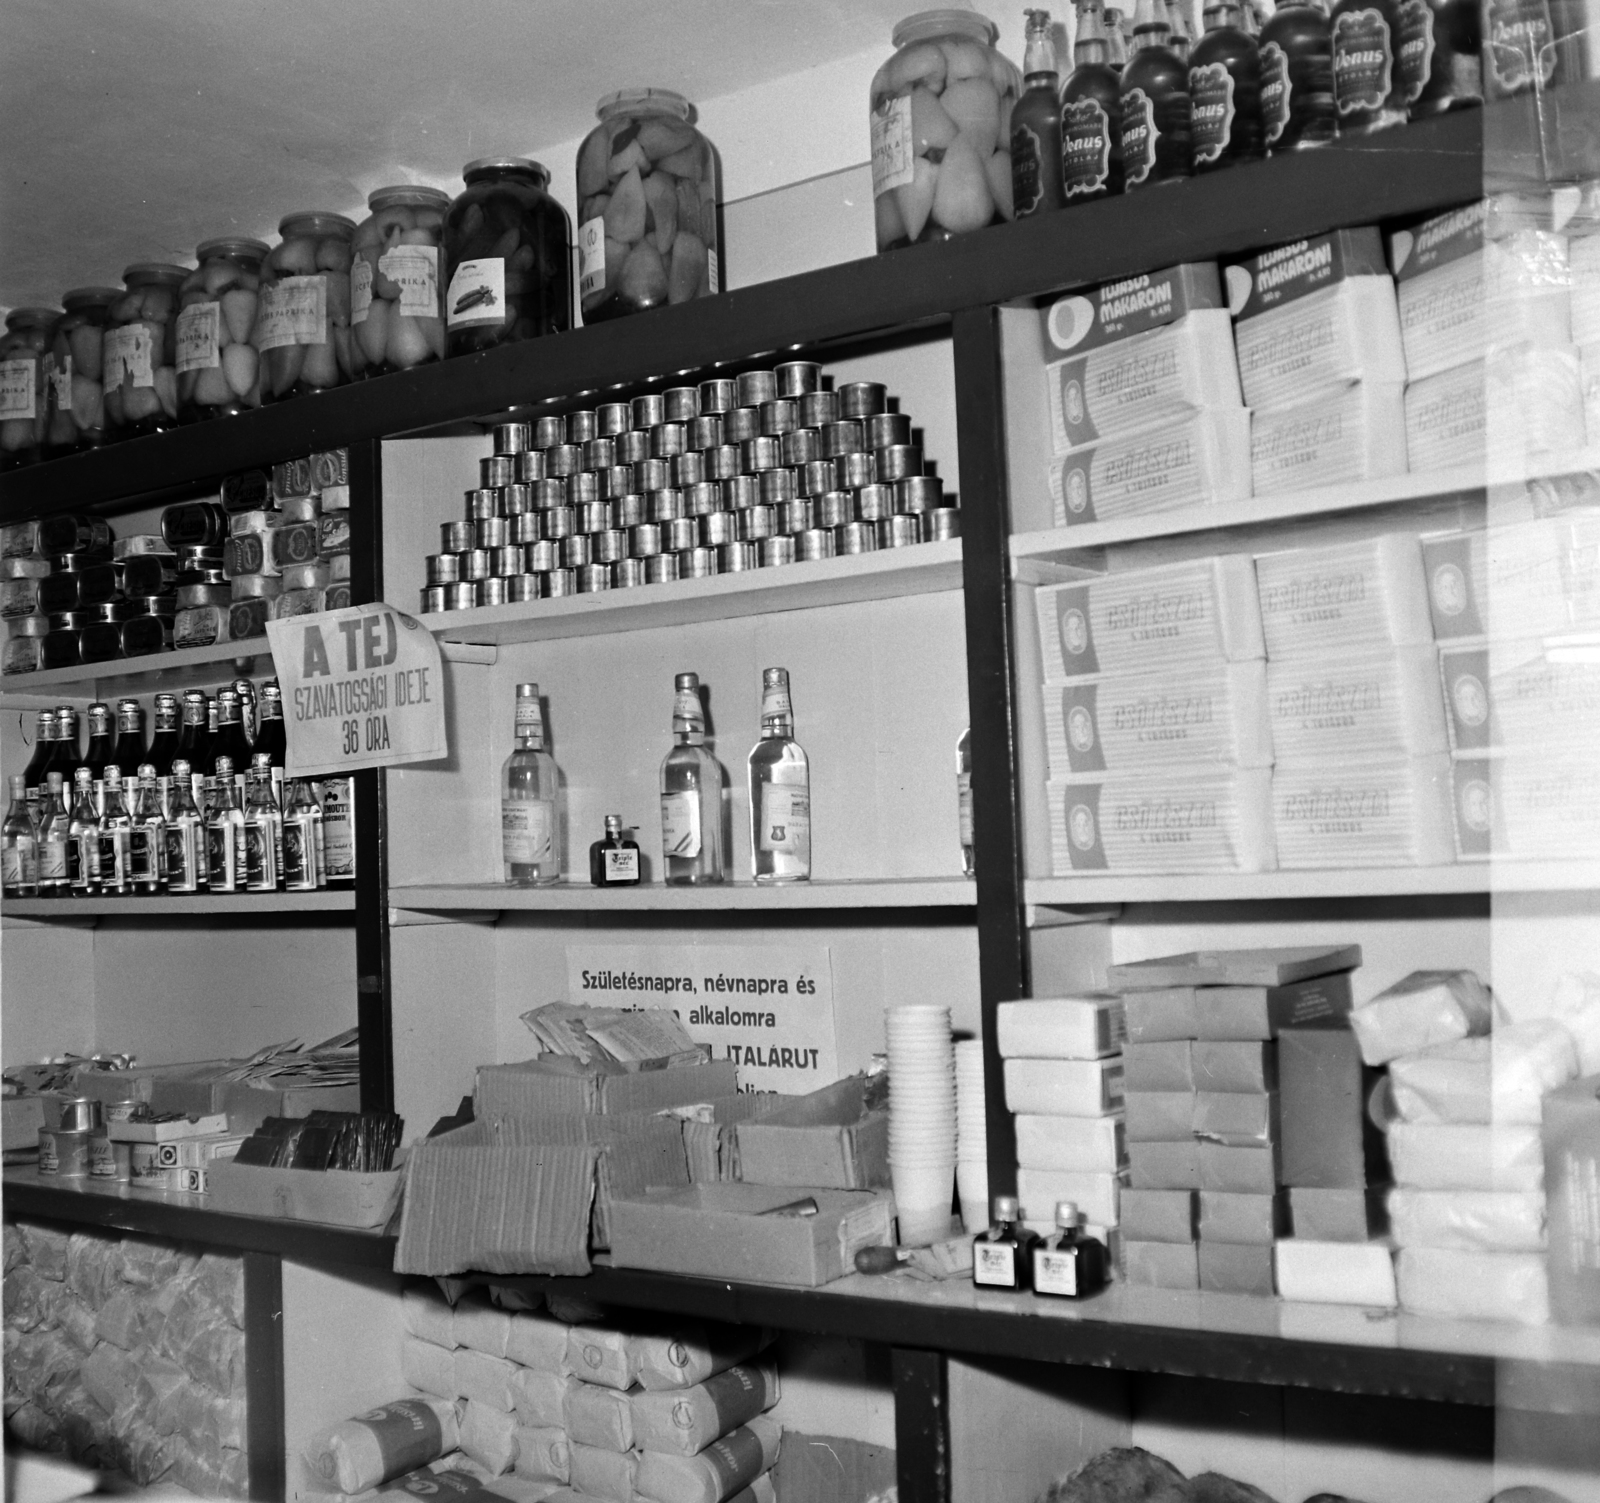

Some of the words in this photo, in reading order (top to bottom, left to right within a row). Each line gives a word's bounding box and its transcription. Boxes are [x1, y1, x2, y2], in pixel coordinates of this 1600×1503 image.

[1258, 242, 1332, 292] MAKARONI
[1100, 280, 1172, 323] MAKARONI
[303, 625, 331, 679] A
[338, 612, 398, 672] TEJ
[294, 672, 388, 721] SZAVATOSSÁGI
[395, 667, 431, 706] IDEJE
[342, 719, 359, 754] 36
[365, 712, 390, 751] ÓRA
[581, 970, 697, 994] Születésnapra,
[704, 974, 788, 995] névnapra
[796, 975, 816, 994] és
[689, 1005, 776, 1027] alkalomra
[726, 1044, 819, 1069] ITALÁRUT
